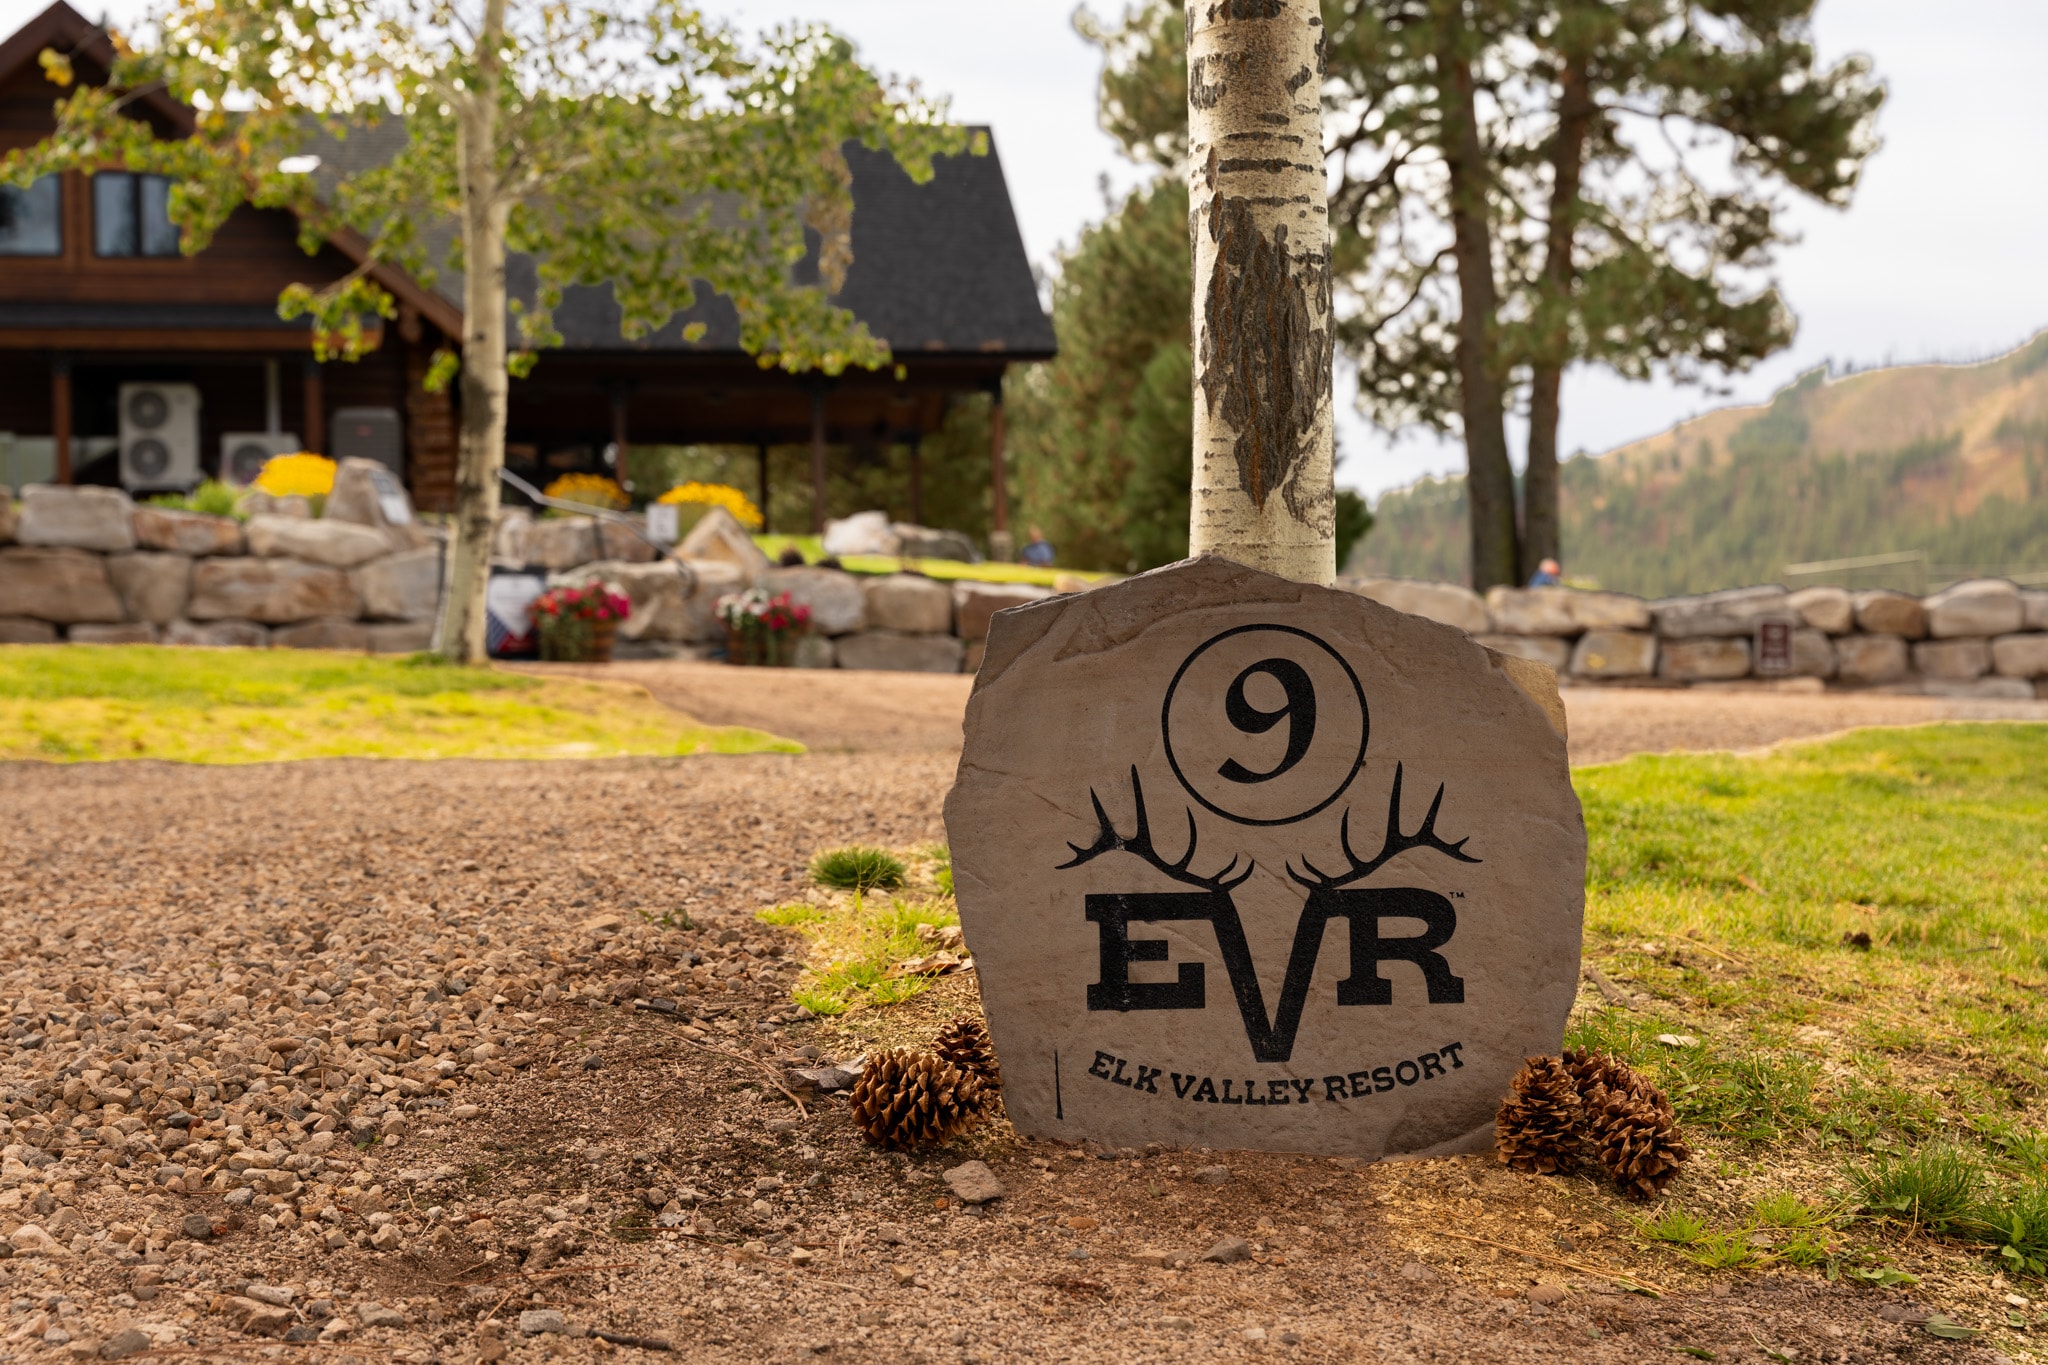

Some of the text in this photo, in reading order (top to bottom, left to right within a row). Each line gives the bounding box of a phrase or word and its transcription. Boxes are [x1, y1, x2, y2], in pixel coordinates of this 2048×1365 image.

[1217, 658, 1317, 783] 9
[1085, 888, 1464, 1062] EVR
[1088, 1042, 1464, 1105] ELK VALLEY RESORT
